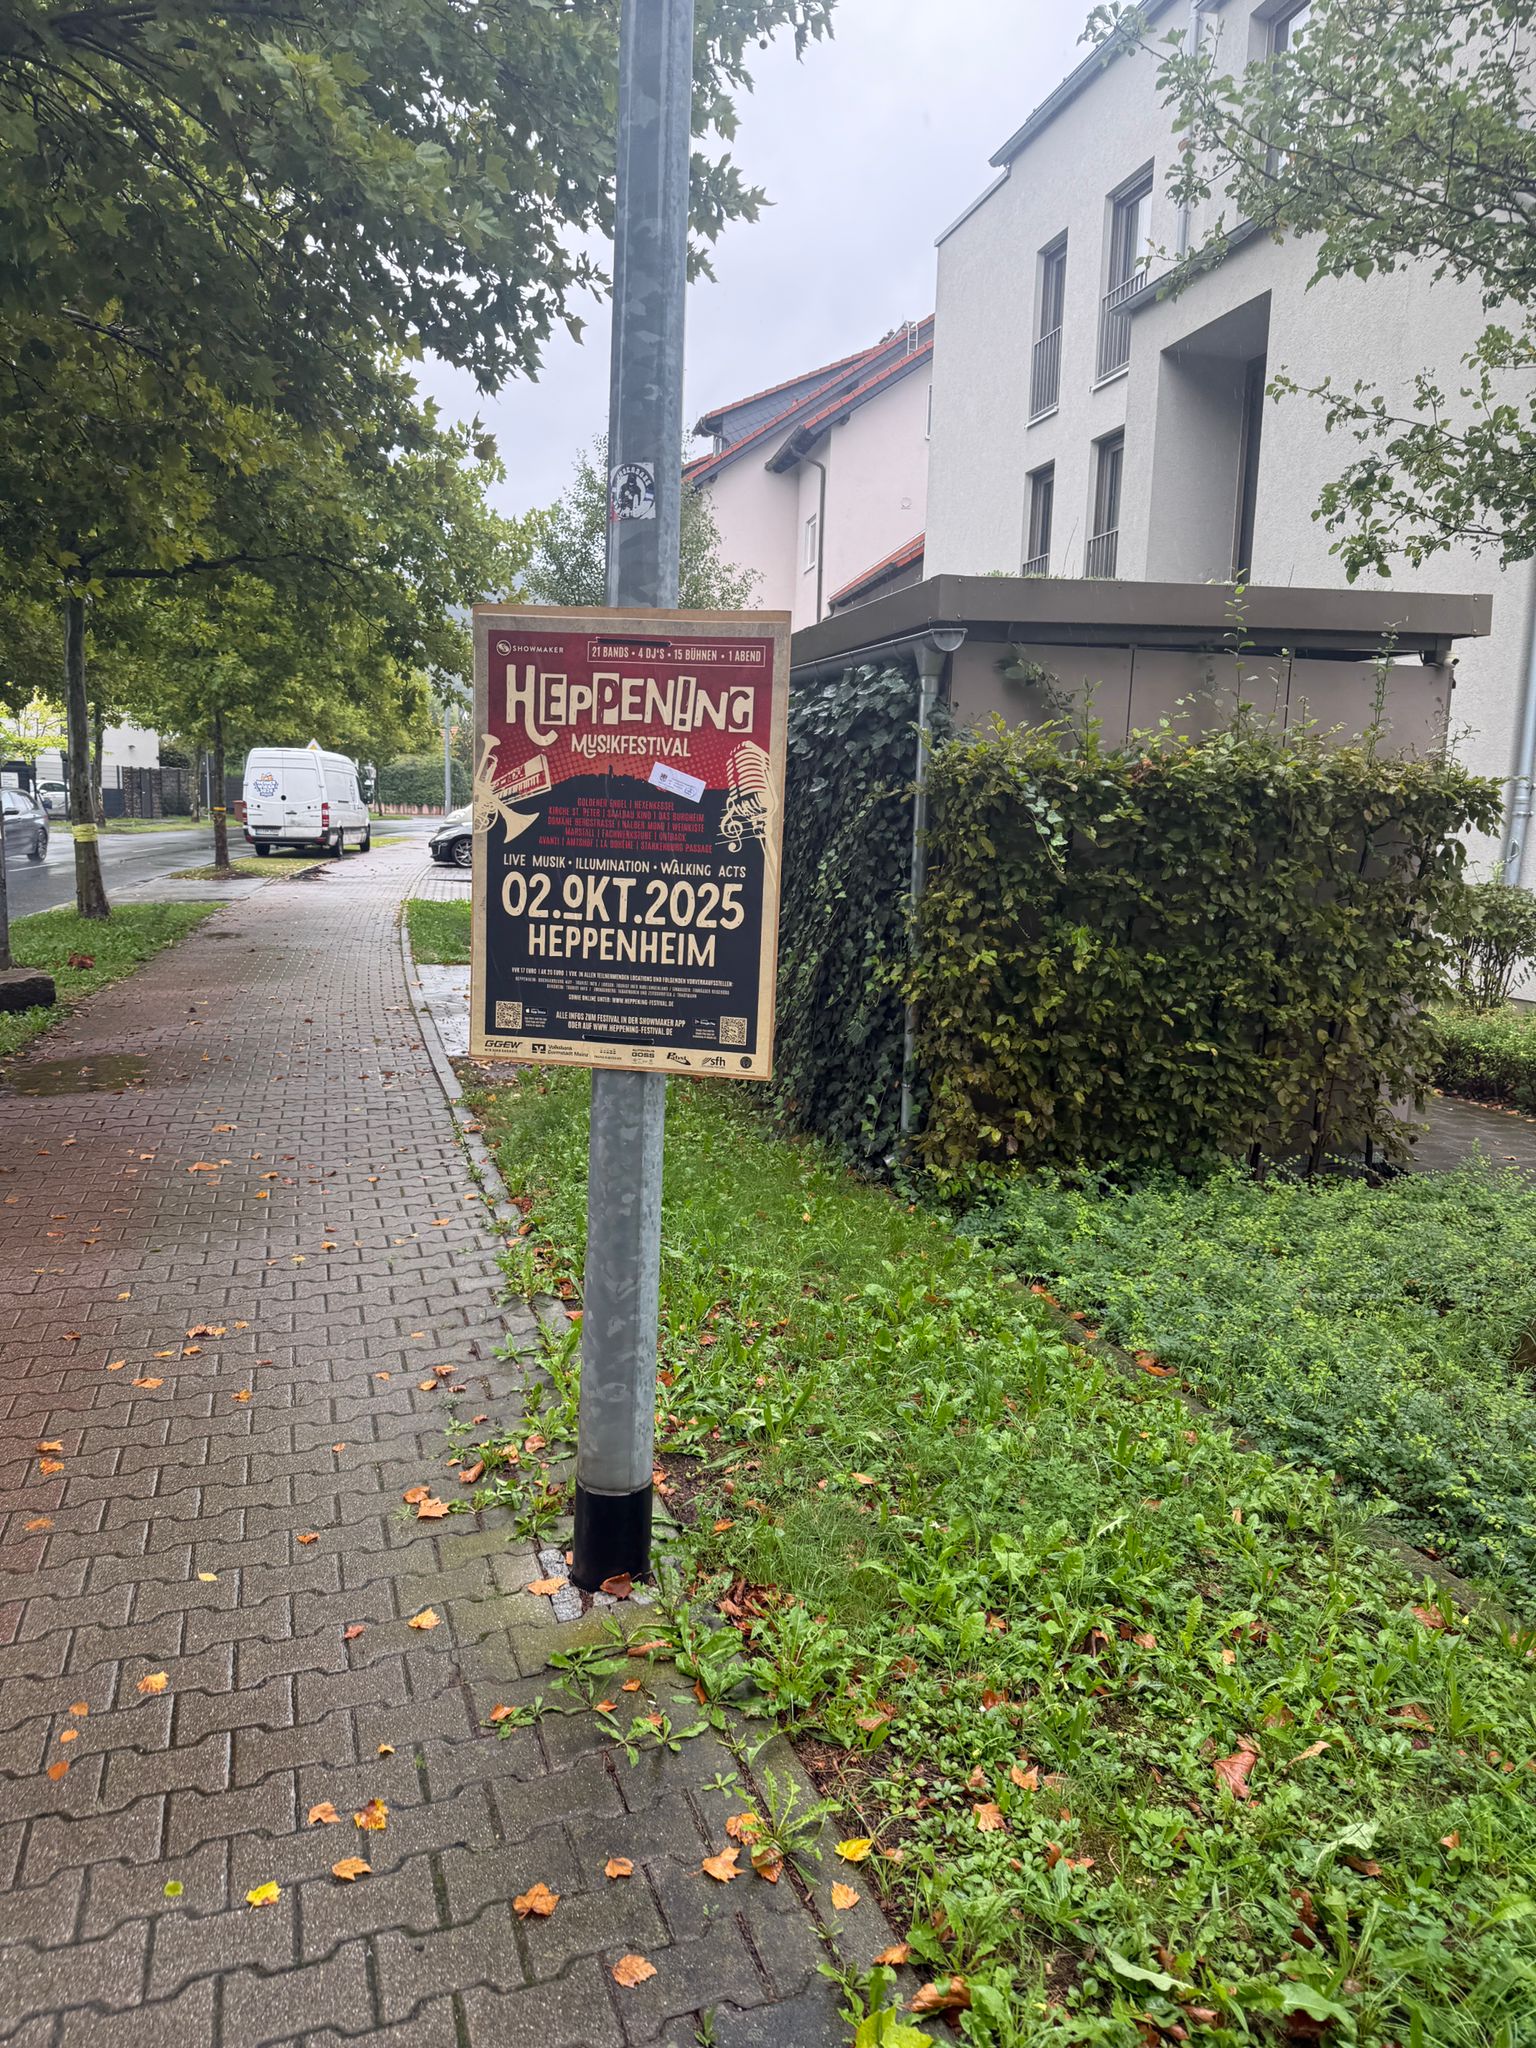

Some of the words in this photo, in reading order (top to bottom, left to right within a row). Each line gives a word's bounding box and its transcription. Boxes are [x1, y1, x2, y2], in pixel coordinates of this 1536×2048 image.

[512, 644, 564, 654] SHOWMAKER
[592, 646, 601, 658] 21
[603, 646, 630, 658] BANDS
[637, 647, 643, 659] 4
[674, 649, 683, 660] 15
[685, 647, 718, 661] BÜHNEN
[728, 650, 732, 661] 1
[735, 650, 761, 662] ABEND
[685, 843, 713, 854] PASSAGE
[503, 853, 526, 867] LIVE
[532, 855, 566, 869] MUSIK
[576, 857, 650, 873] ILLUMINATION
[660, 859, 712, 877] WALKING
[718, 865, 747, 878] ACTS
[528, 923, 716, 968] HEPPENHEIM
[556, 1010, 568, 1020] ALLE
[568, 1011, 585, 1021] INFOS
[585, 1013, 597, 1022] ZUM
[597, 1014, 621, 1024] FESTIVAL
[621, 1016, 627, 1024] IN
[628, 1017, 639, 1026] DER
[639, 1018, 674, 1028] SHOWMAKER
[674, 1019, 686, 1028] APP
[568, 1021, 582, 1030] ODER
[582, 1022, 593, 1031] AUF
[593, 1023, 673, 1036] WWW.HEPPENING-FESTIVAL.DE
[484, 1040, 522, 1048] GGEW
[711, 1056, 726, 1066] sfh
